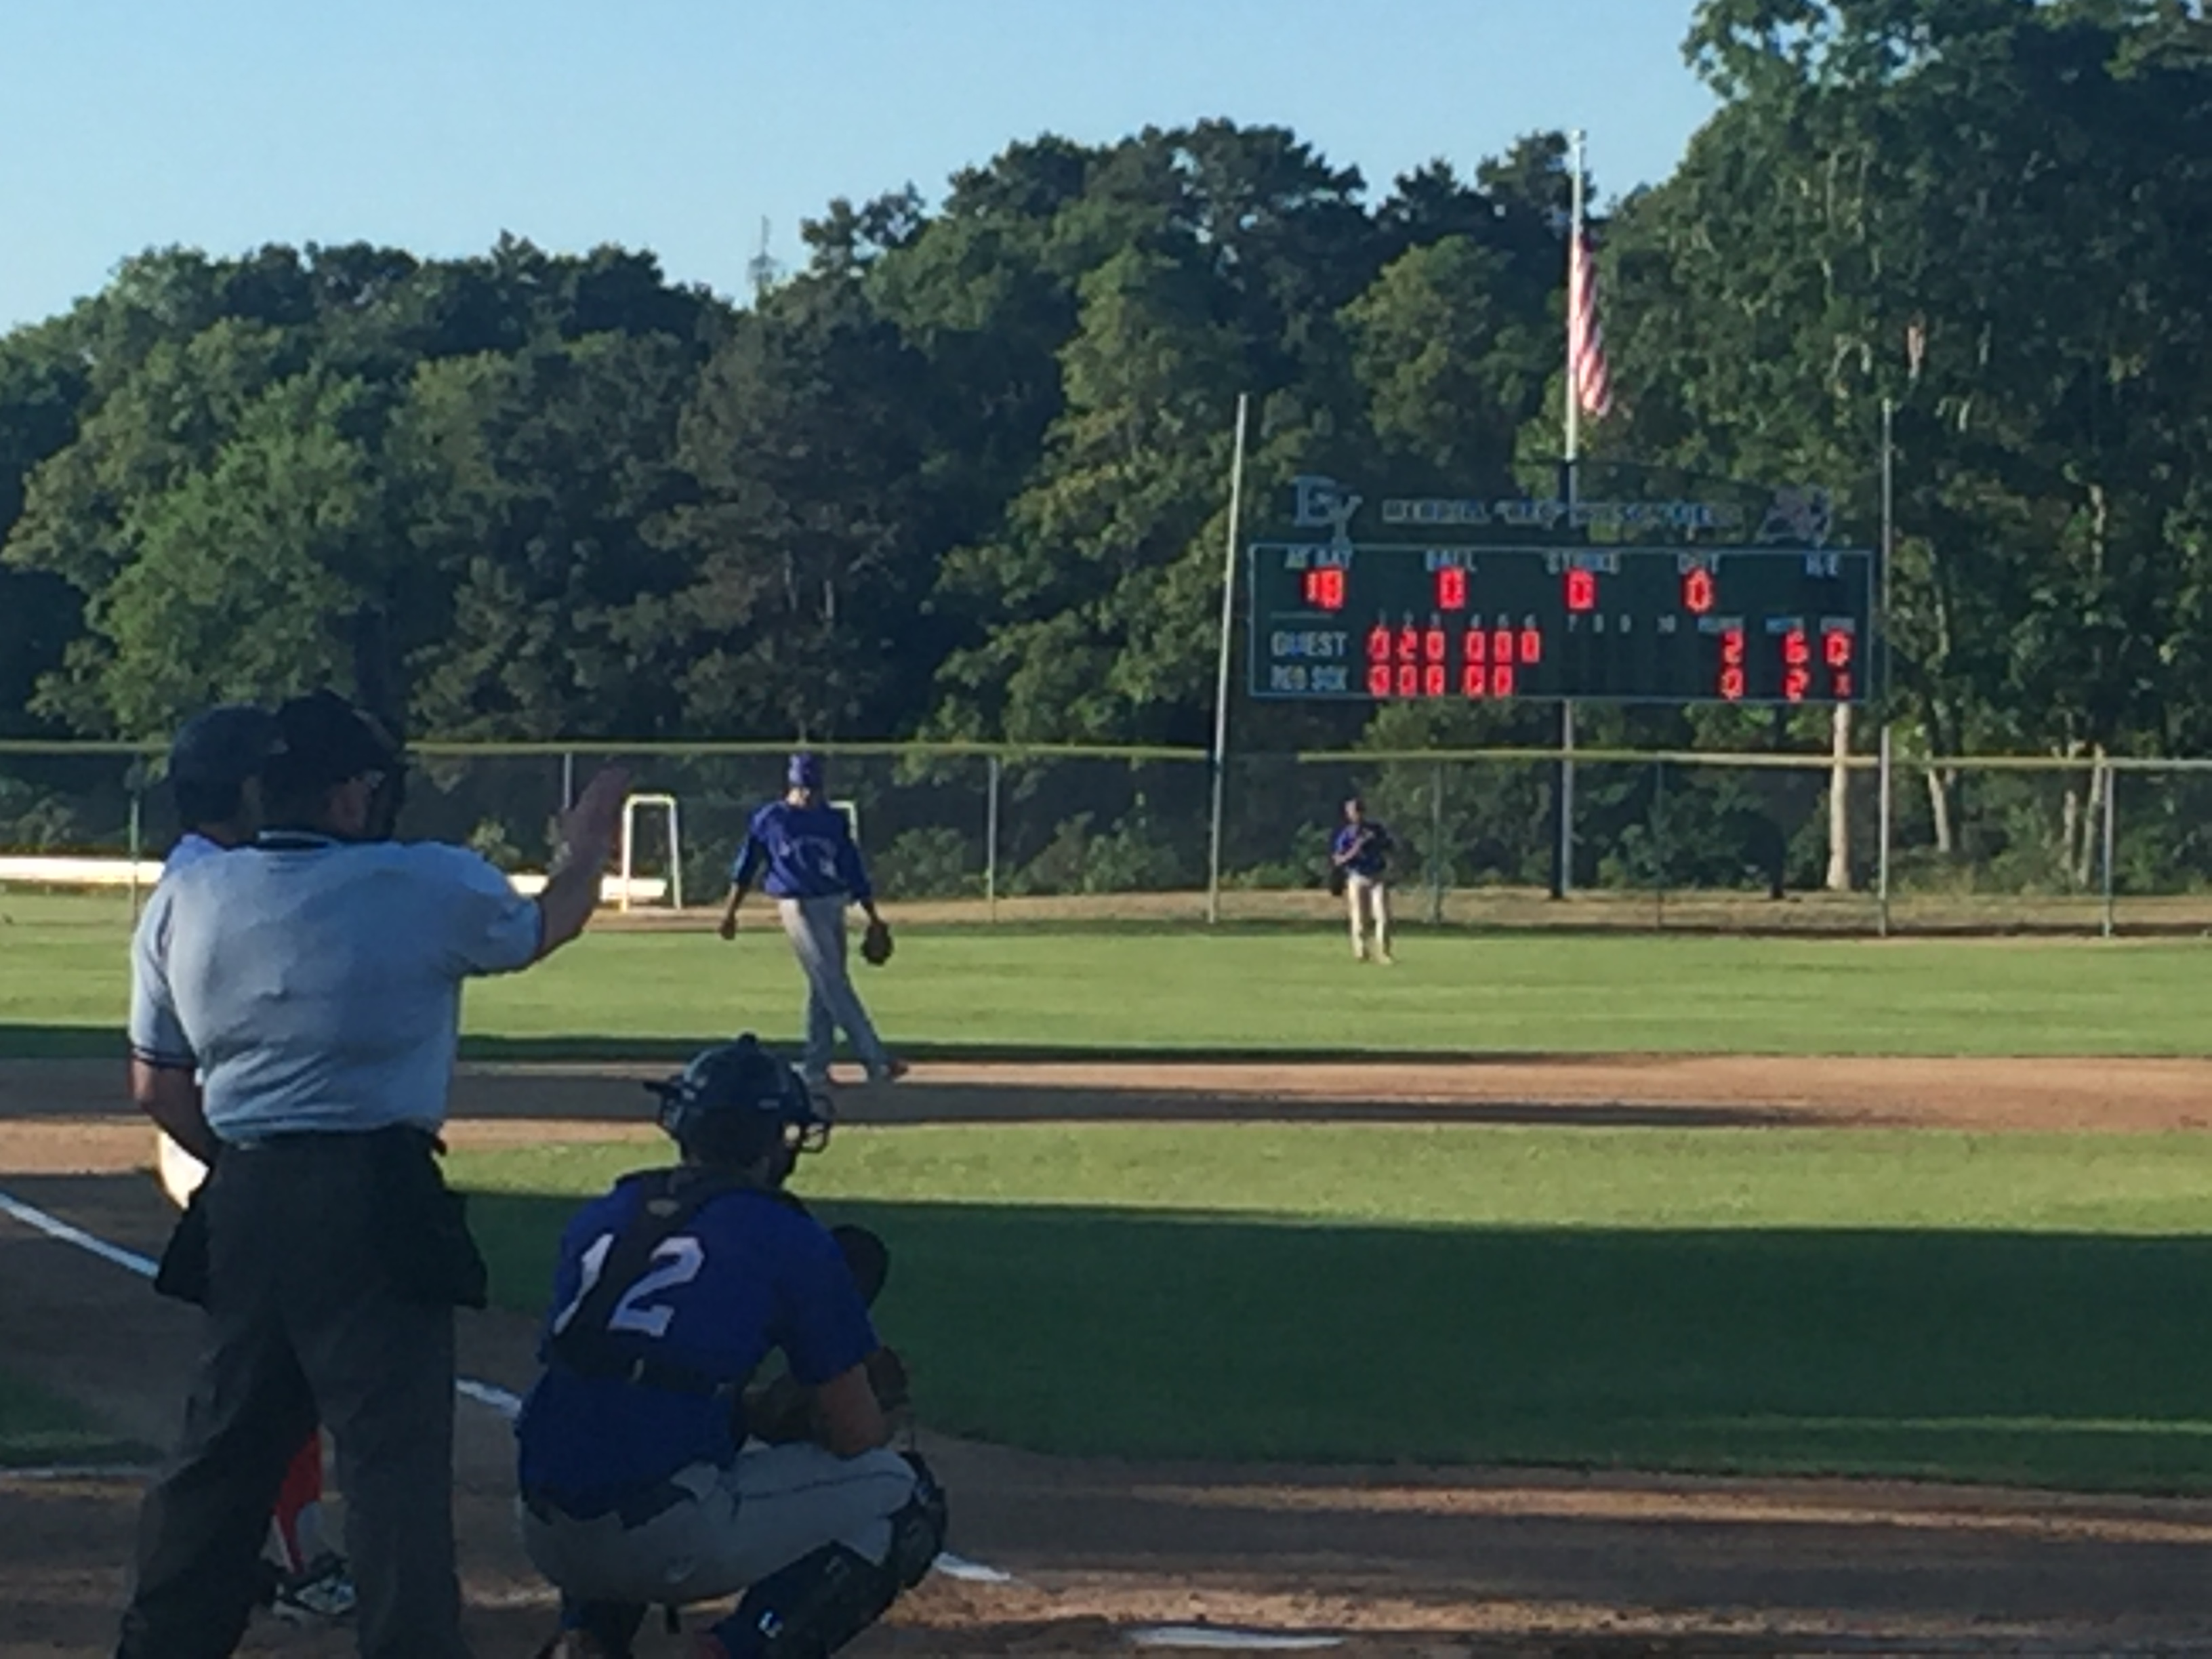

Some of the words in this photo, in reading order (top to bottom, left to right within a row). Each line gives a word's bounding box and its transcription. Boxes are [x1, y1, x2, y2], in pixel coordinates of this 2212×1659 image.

[1426, 550, 1476, 571] BALL
[1438, 568, 1466, 609] 0
[1568, 569, 1594, 609] 0
[1685, 569, 1713, 612] 0
[1271, 631, 1348, 658] GUEST
[552, 1233, 705, 1337] 12
